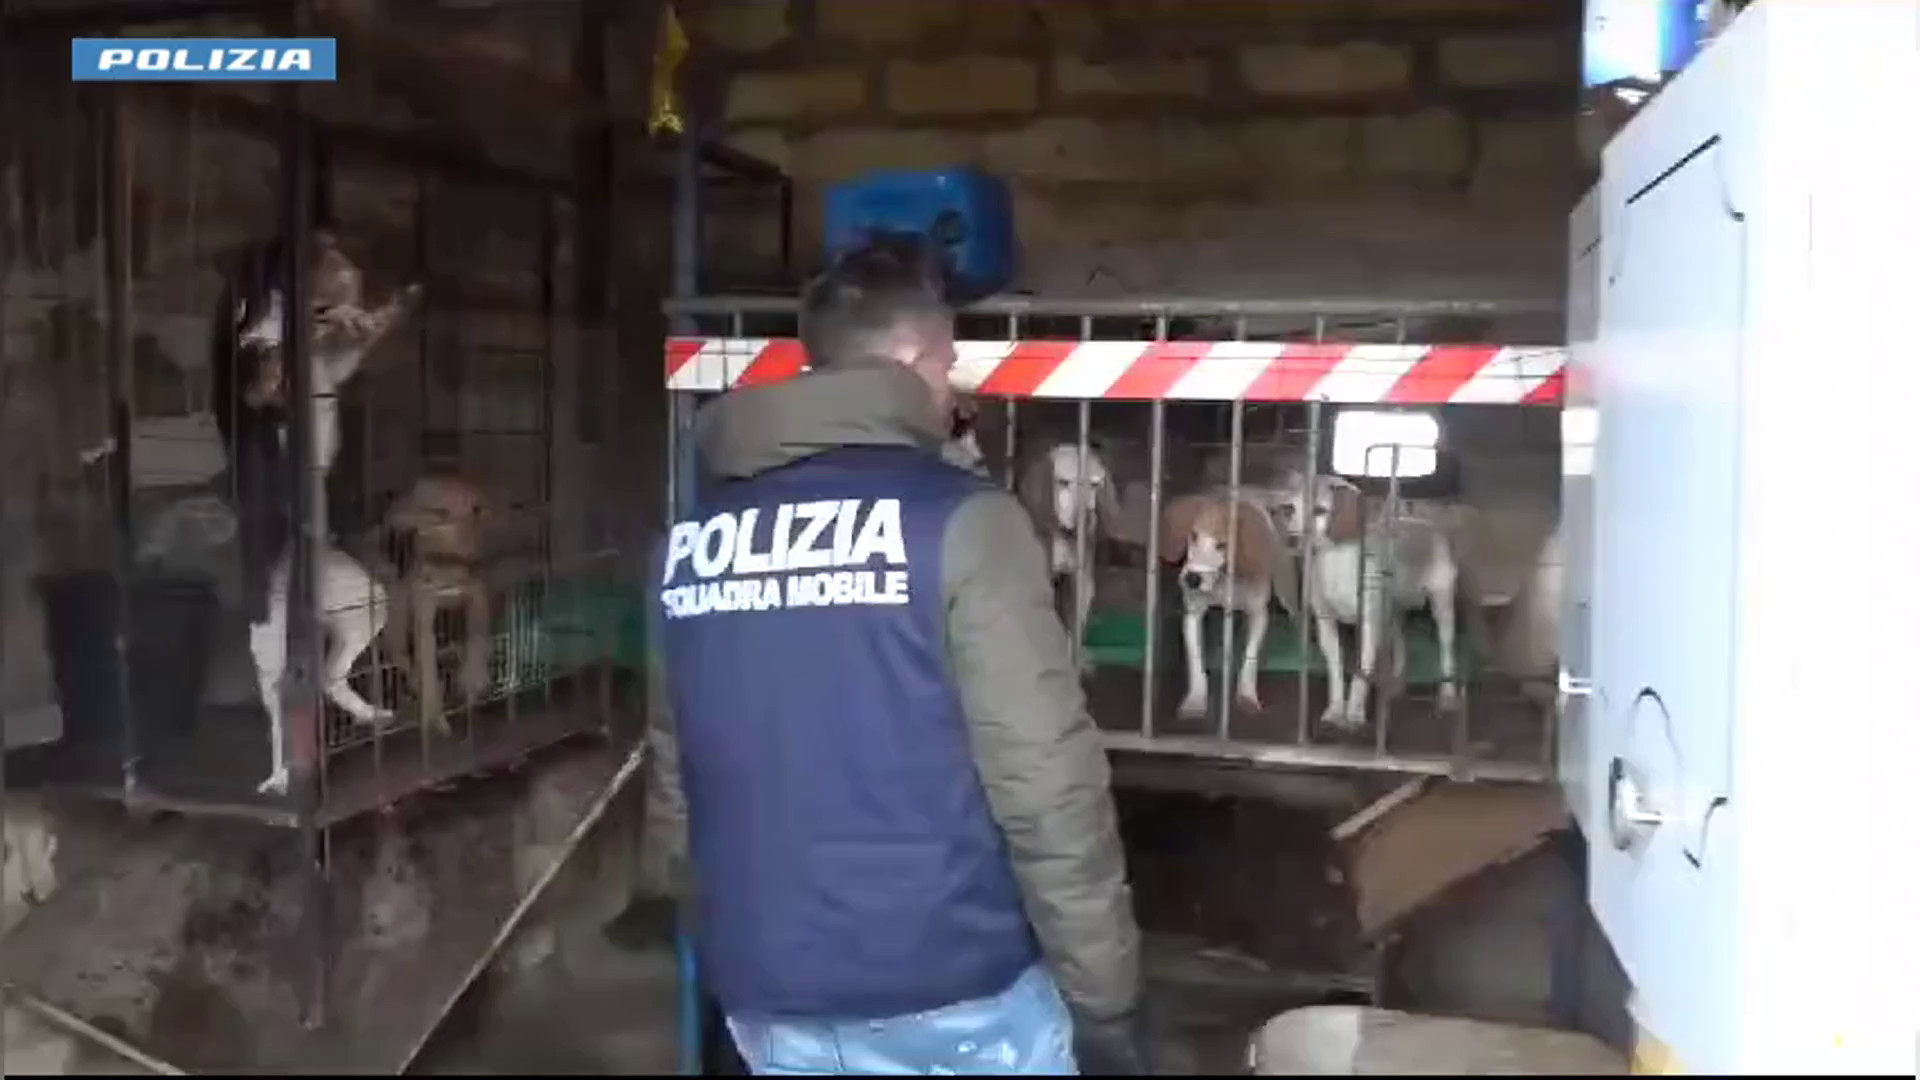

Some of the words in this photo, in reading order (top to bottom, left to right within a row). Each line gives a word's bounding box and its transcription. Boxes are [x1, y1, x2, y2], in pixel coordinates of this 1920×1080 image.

[664, 499, 908, 585] POLIZIA
[662, 578, 782, 619] SQUADRA
[786, 571, 909, 607] MOBILE
